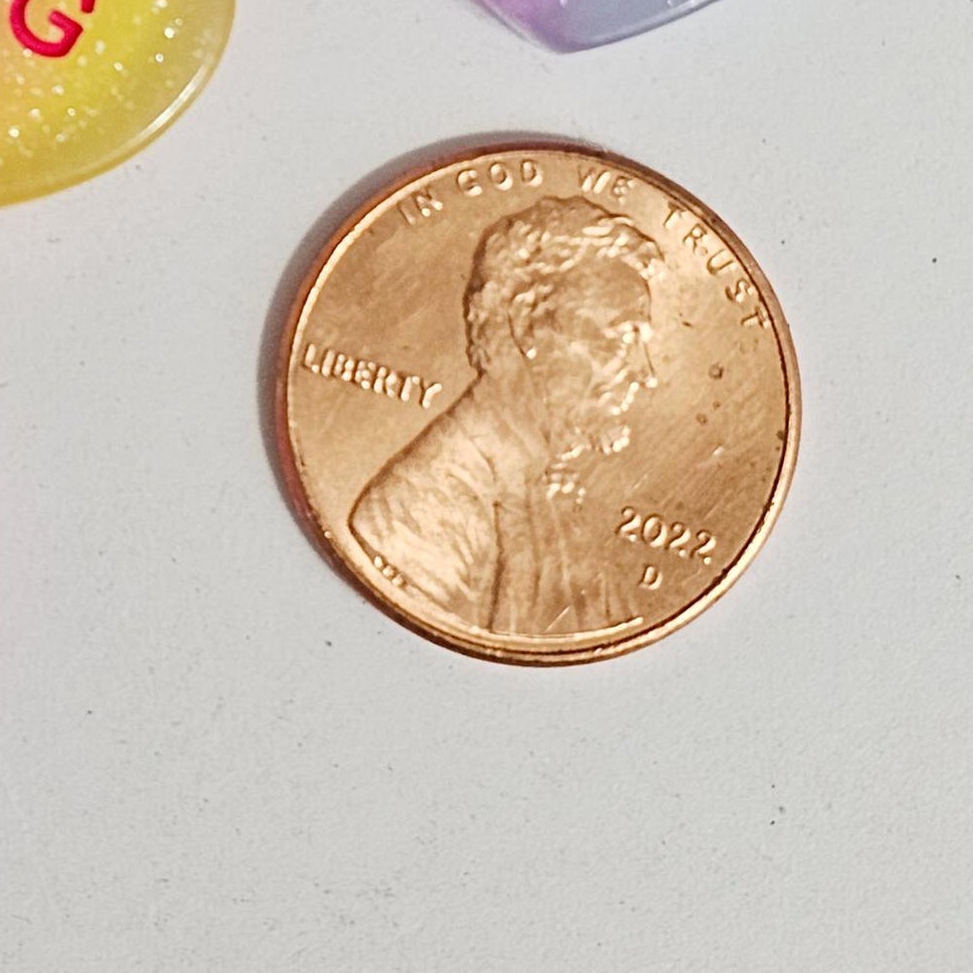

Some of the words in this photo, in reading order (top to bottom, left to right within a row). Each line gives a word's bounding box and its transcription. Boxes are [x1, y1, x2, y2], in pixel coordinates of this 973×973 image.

[398, 192, 443, 226] IN
[457, 159, 545, 197] GOD
[577, 166, 635, 202] WE
[662, 205, 772, 330] TRUST
[302, 342, 443, 409] LIBERTY
[616, 506, 719, 567] 2022
[639, 565, 664, 591] D
